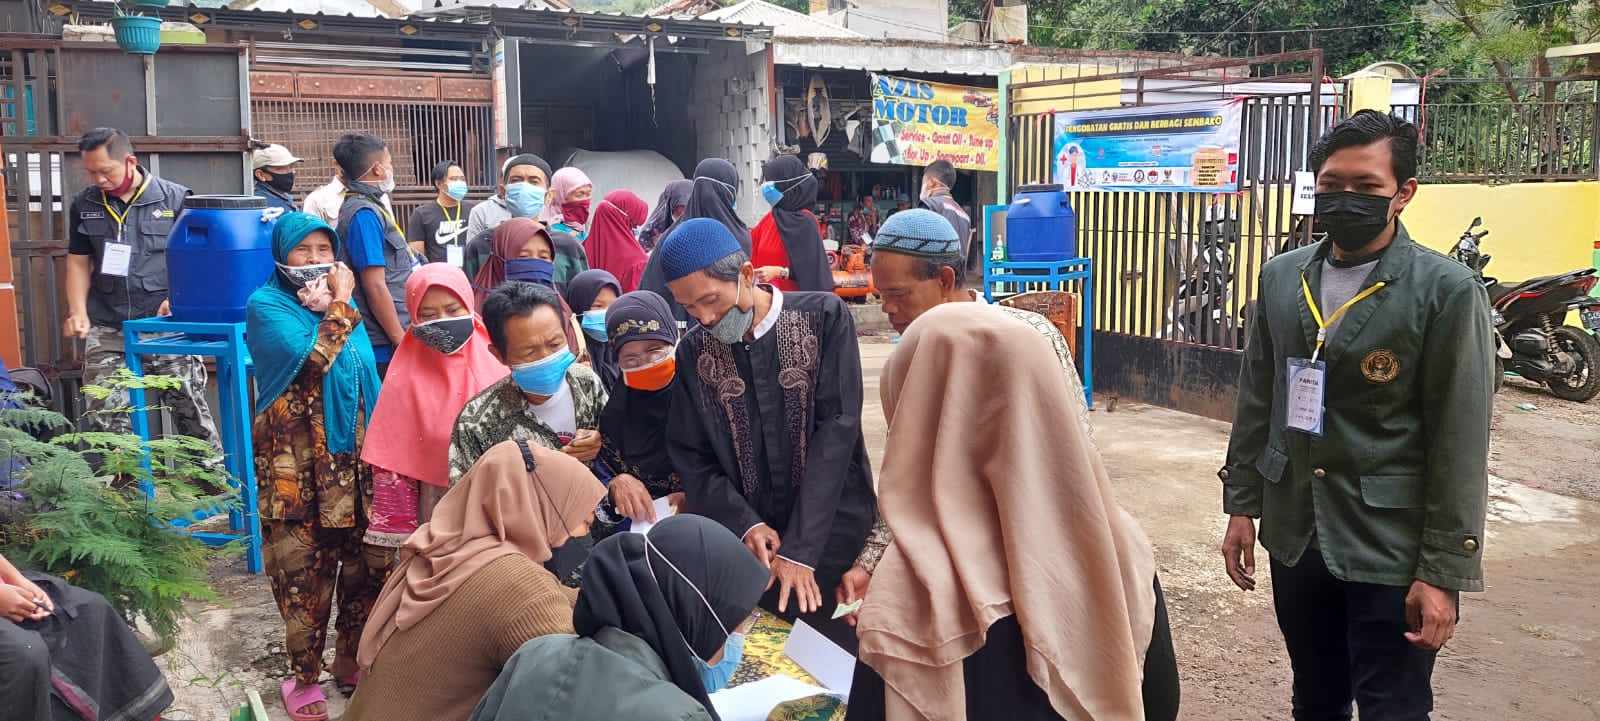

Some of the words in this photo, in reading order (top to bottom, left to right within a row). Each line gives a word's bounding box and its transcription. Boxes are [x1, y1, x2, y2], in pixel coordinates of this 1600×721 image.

[874, 99, 968, 127] MOTOR
[1066, 122, 1108, 133] PENGOBATAN
[1109, 121, 1133, 131] GRATIS
[1134, 120, 1150, 130] DAN
[1151, 118, 1182, 129] BERBAGI
[1184, 115, 1222, 127] SEMBAKO
[901, 129, 926, 143] Service
[969, 134, 984, 147] Tune
[440, 220, 465, 234] NIKE
